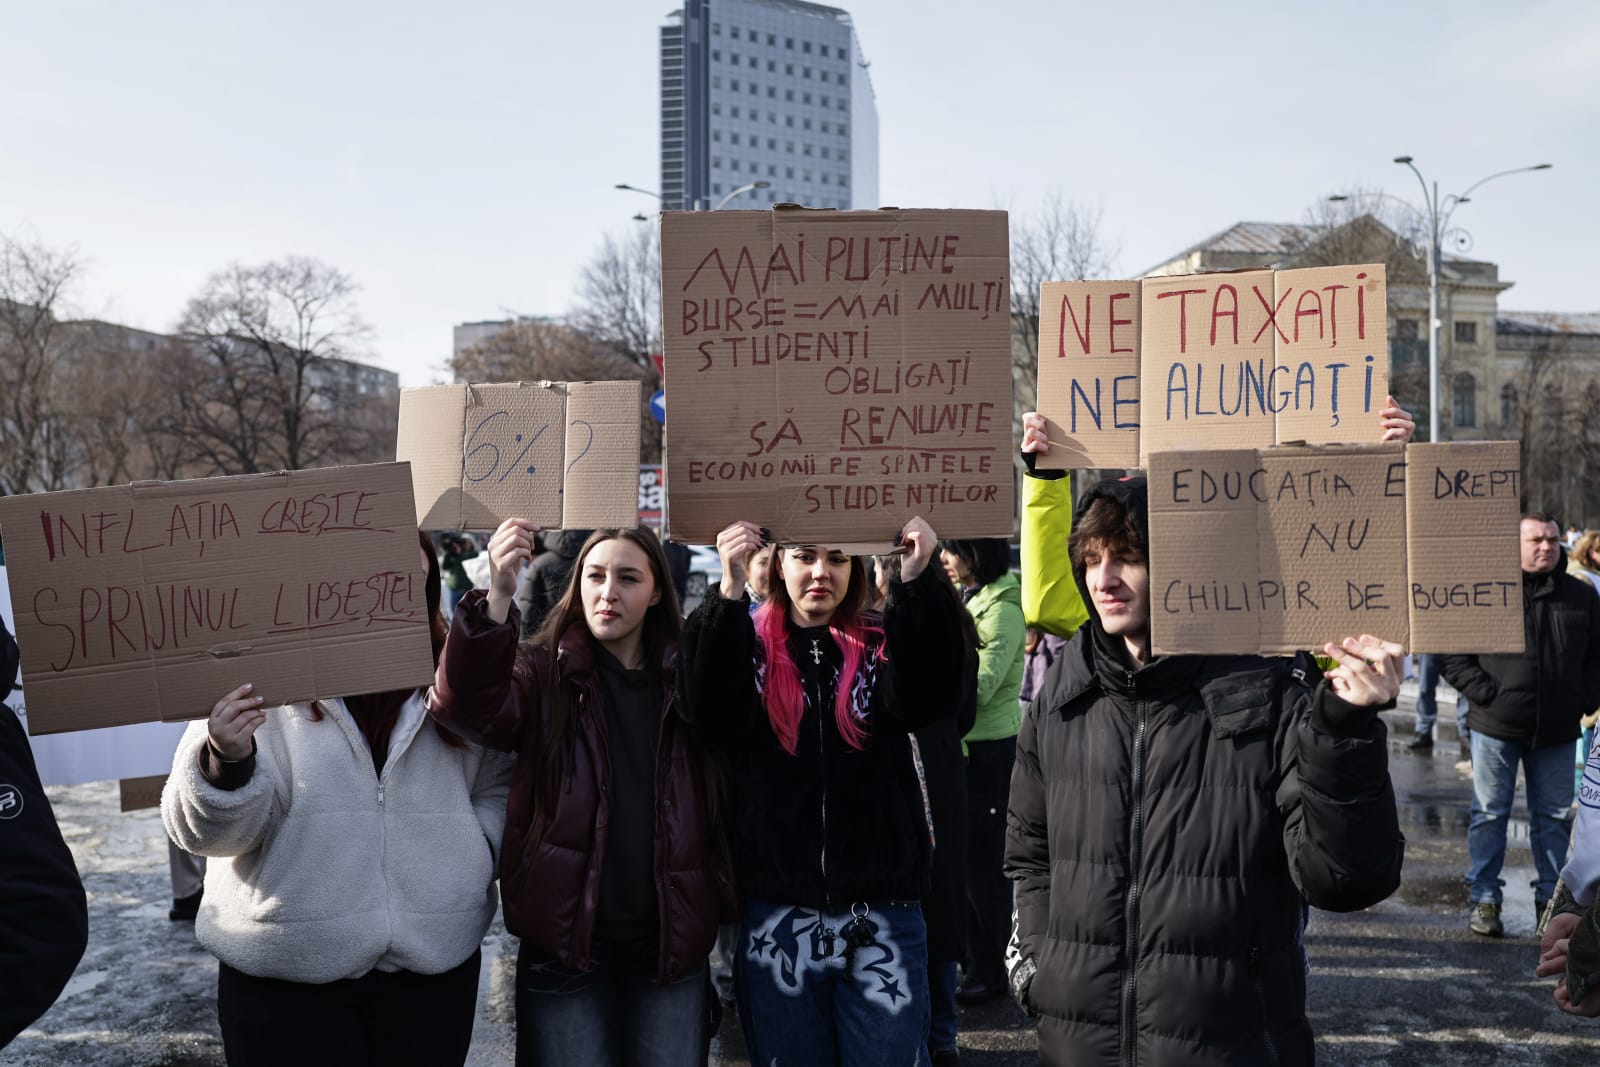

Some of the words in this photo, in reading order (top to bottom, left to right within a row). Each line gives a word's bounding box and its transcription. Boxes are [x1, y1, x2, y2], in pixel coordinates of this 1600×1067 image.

[682, 298, 786, 335] BURSE
[1058, 293, 1134, 357] NE
[1070, 375, 1141, 433] NE
[747, 407, 803, 458] SĂ
[840, 402, 994, 446] RENUNȚE
[830, 456, 863, 477] PE
[880, 452, 991, 476] SPATELE
[1384, 463, 1408, 498] E
[1434, 466, 1520, 500] DREPT
[261, 492, 380, 537] CREȘTE
[1300, 518, 1370, 558] NU
[1346, 580, 1390, 612] DE
[1411, 581, 1518, 610] BUGET
[33, 583, 249, 672] SPRIJINUL
